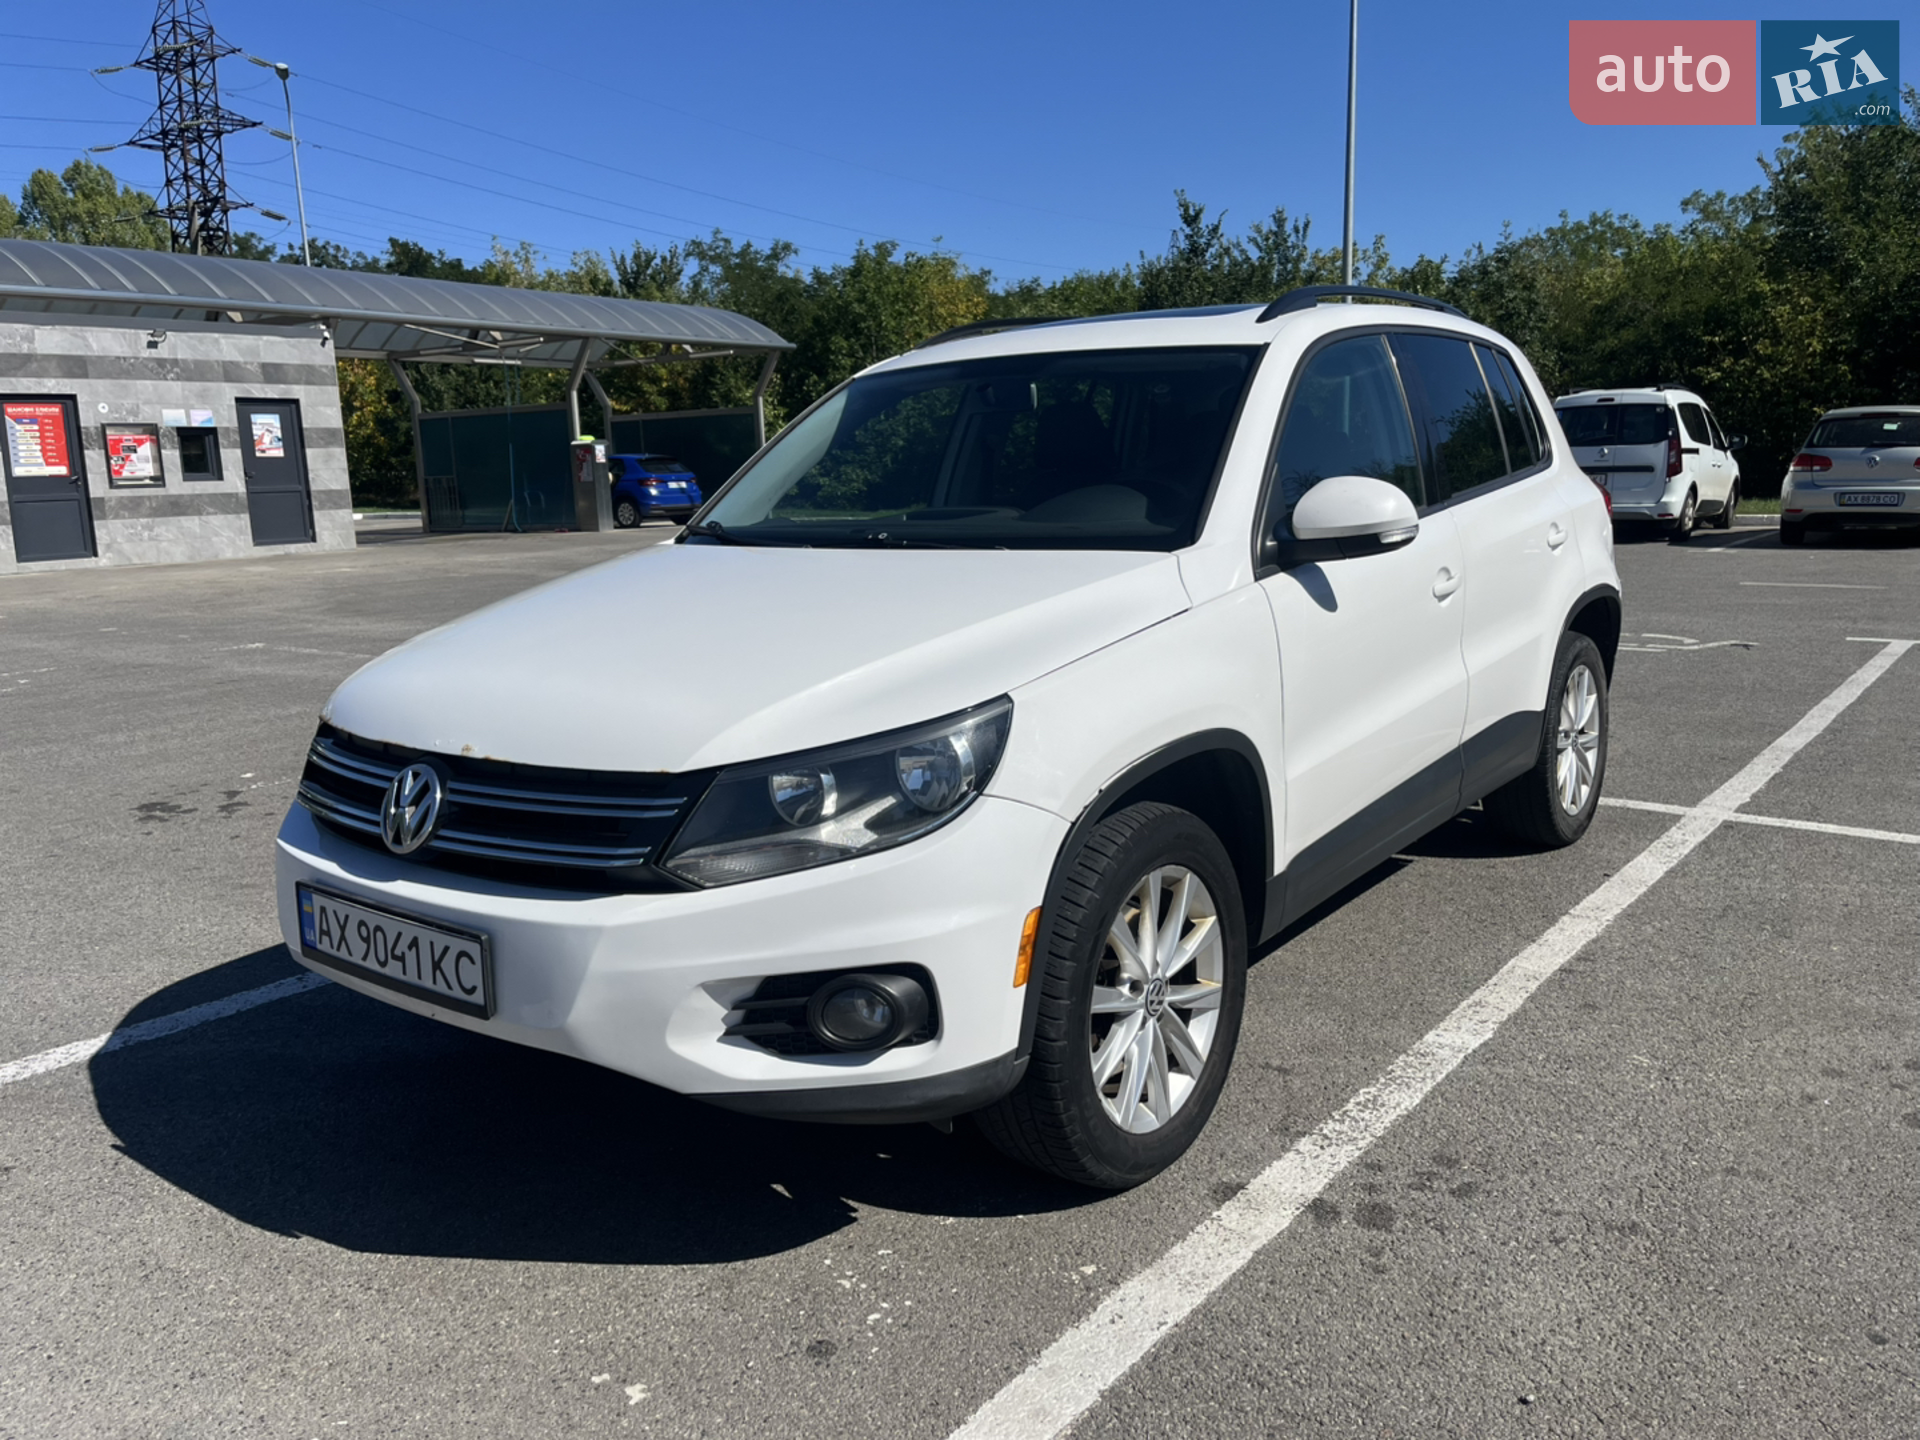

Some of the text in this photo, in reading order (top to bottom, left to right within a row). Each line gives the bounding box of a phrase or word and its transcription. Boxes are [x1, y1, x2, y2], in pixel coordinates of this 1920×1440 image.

[319, 905, 478, 996] AX 9041 KC
